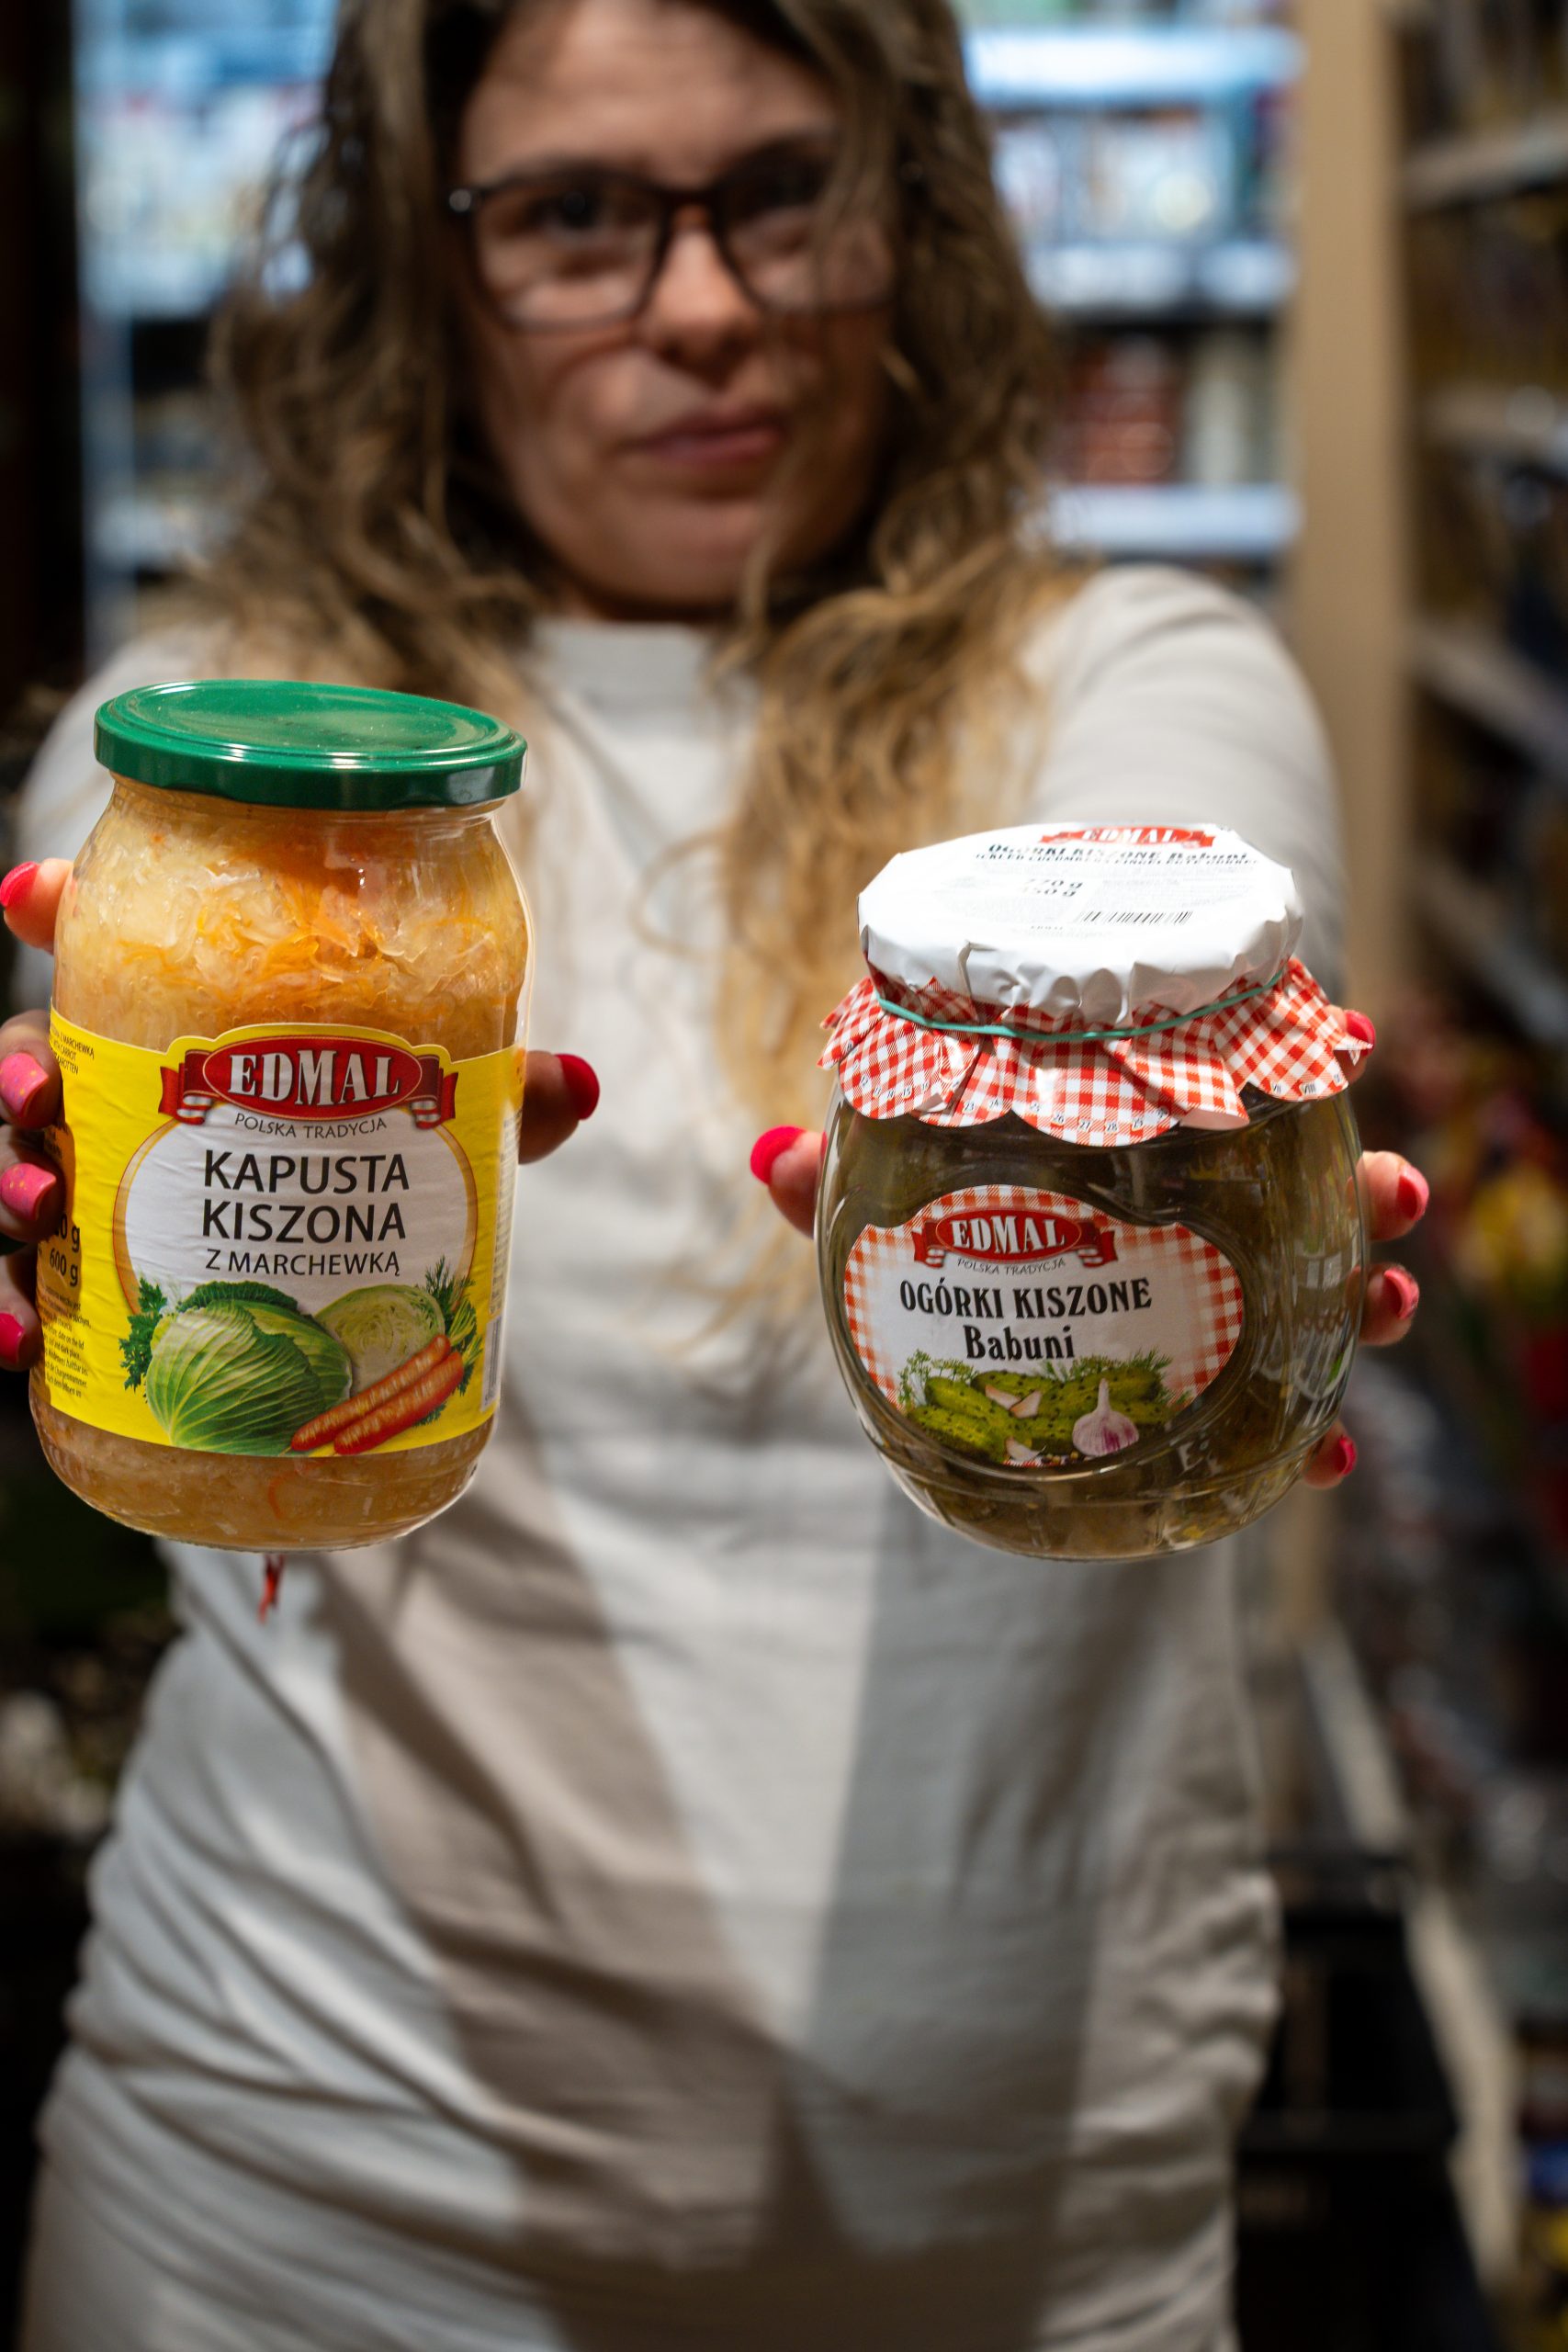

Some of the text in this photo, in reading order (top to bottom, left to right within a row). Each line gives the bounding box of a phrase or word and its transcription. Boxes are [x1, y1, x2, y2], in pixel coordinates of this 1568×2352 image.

[228, 1049, 400, 1106] EDMAL
[234, 1113, 388, 1139] POLSKA TRADYCJA
[204, 1149, 410, 1195] KAPUSTA
[202, 1198, 407, 1245] KISZONA
[951, 1215, 1066, 1254] EDMAL
[50, 1248, 79, 1287] 600 g
[205, 1248, 400, 1278] Z MARCHEWKĄ
[957, 1257, 1066, 1275] POLSKA TRADYCJA
[899, 1277, 1152, 1318] OGÓRKI KISZONE
[964, 1325, 1075, 1360] Babuni
